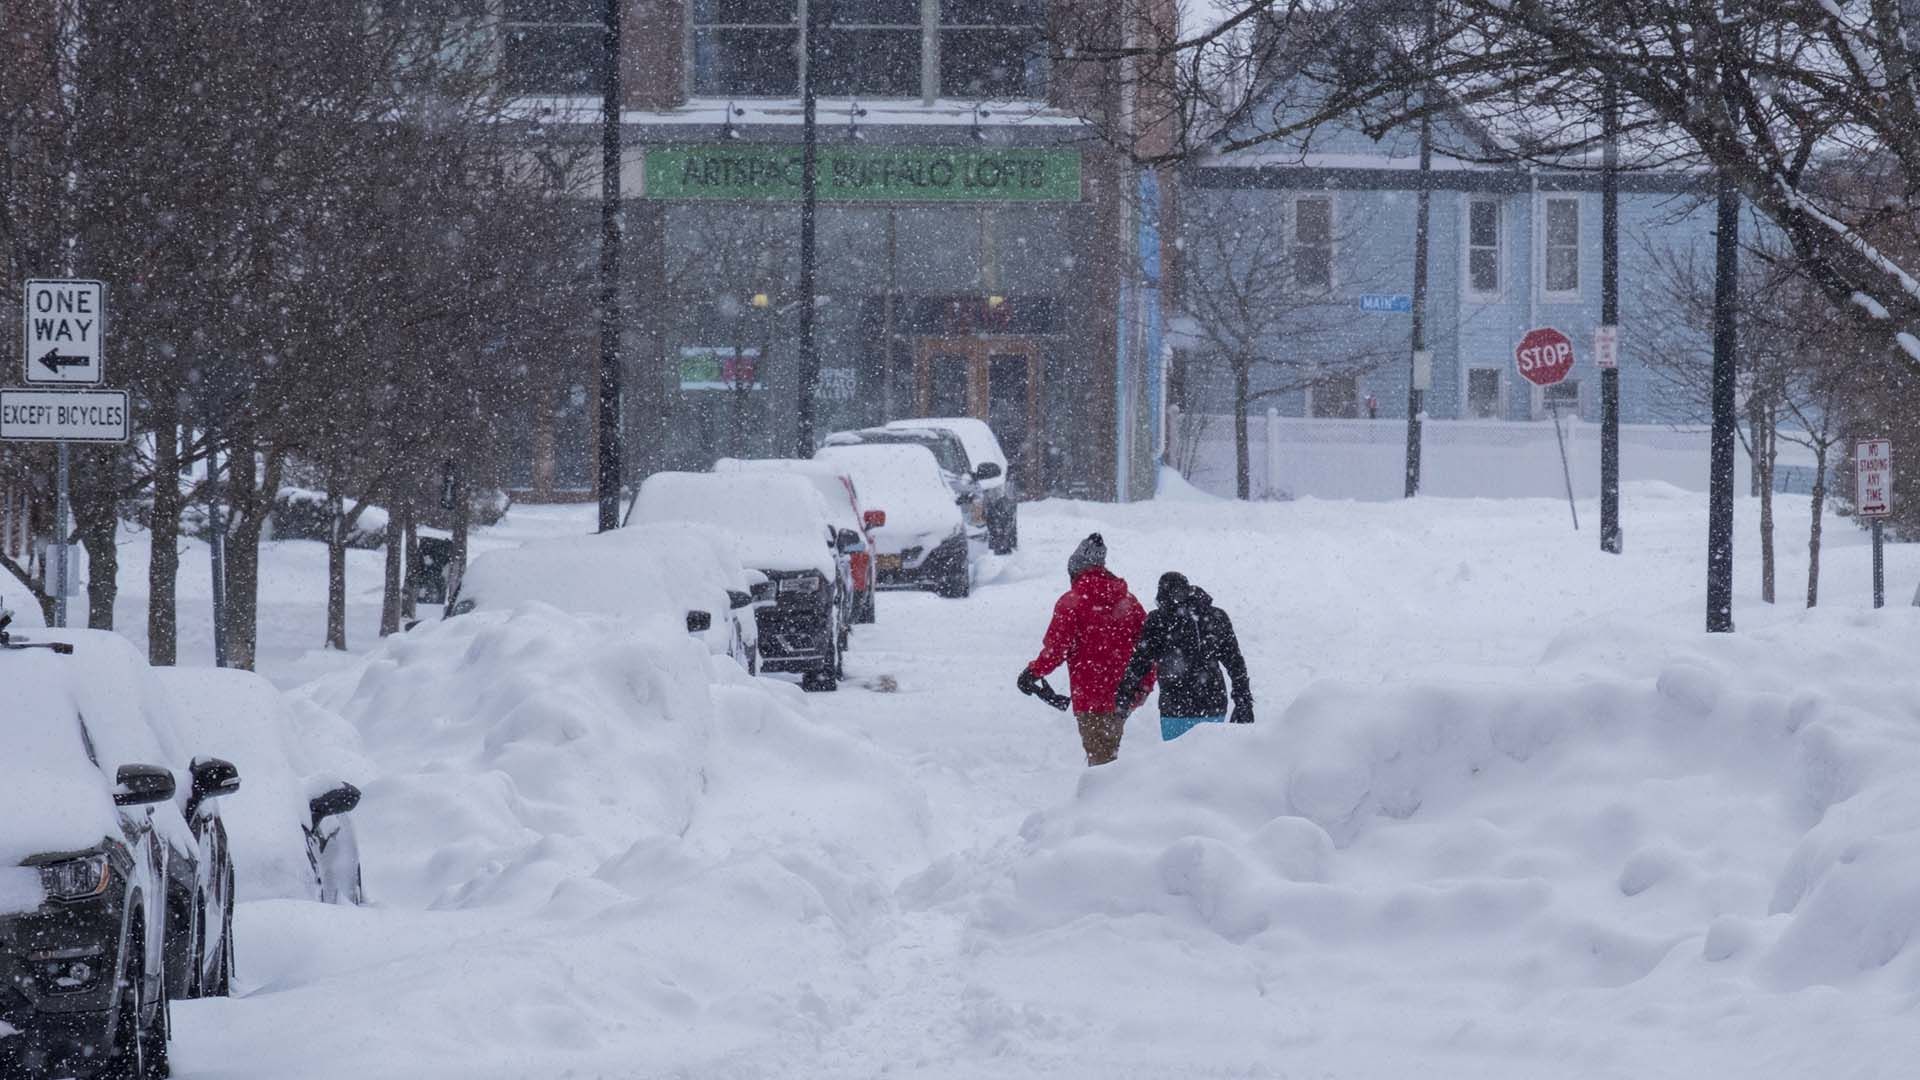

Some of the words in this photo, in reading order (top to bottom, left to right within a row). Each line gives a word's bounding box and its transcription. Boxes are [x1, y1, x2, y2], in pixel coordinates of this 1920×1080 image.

[682, 157, 822, 186] ARTSPAC
[832, 158, 952, 187] BUFFALO
[963, 158, 1044, 188] LOFTS
[36, 289, 92, 313] ONE
[1363, 297, 1391, 310] MAIN
[34, 317, 93, 342] WAY
[1520, 343, 1570, 371] STOP
[3, 404, 52, 425] EXCEPT
[57, 405, 122, 426] BICYCLES
[1868, 444, 1878, 456] NO
[1860, 458, 1888, 472] STANDING
[1868, 473, 1880, 487] ANY
[1866, 488, 1882, 501] TIME
